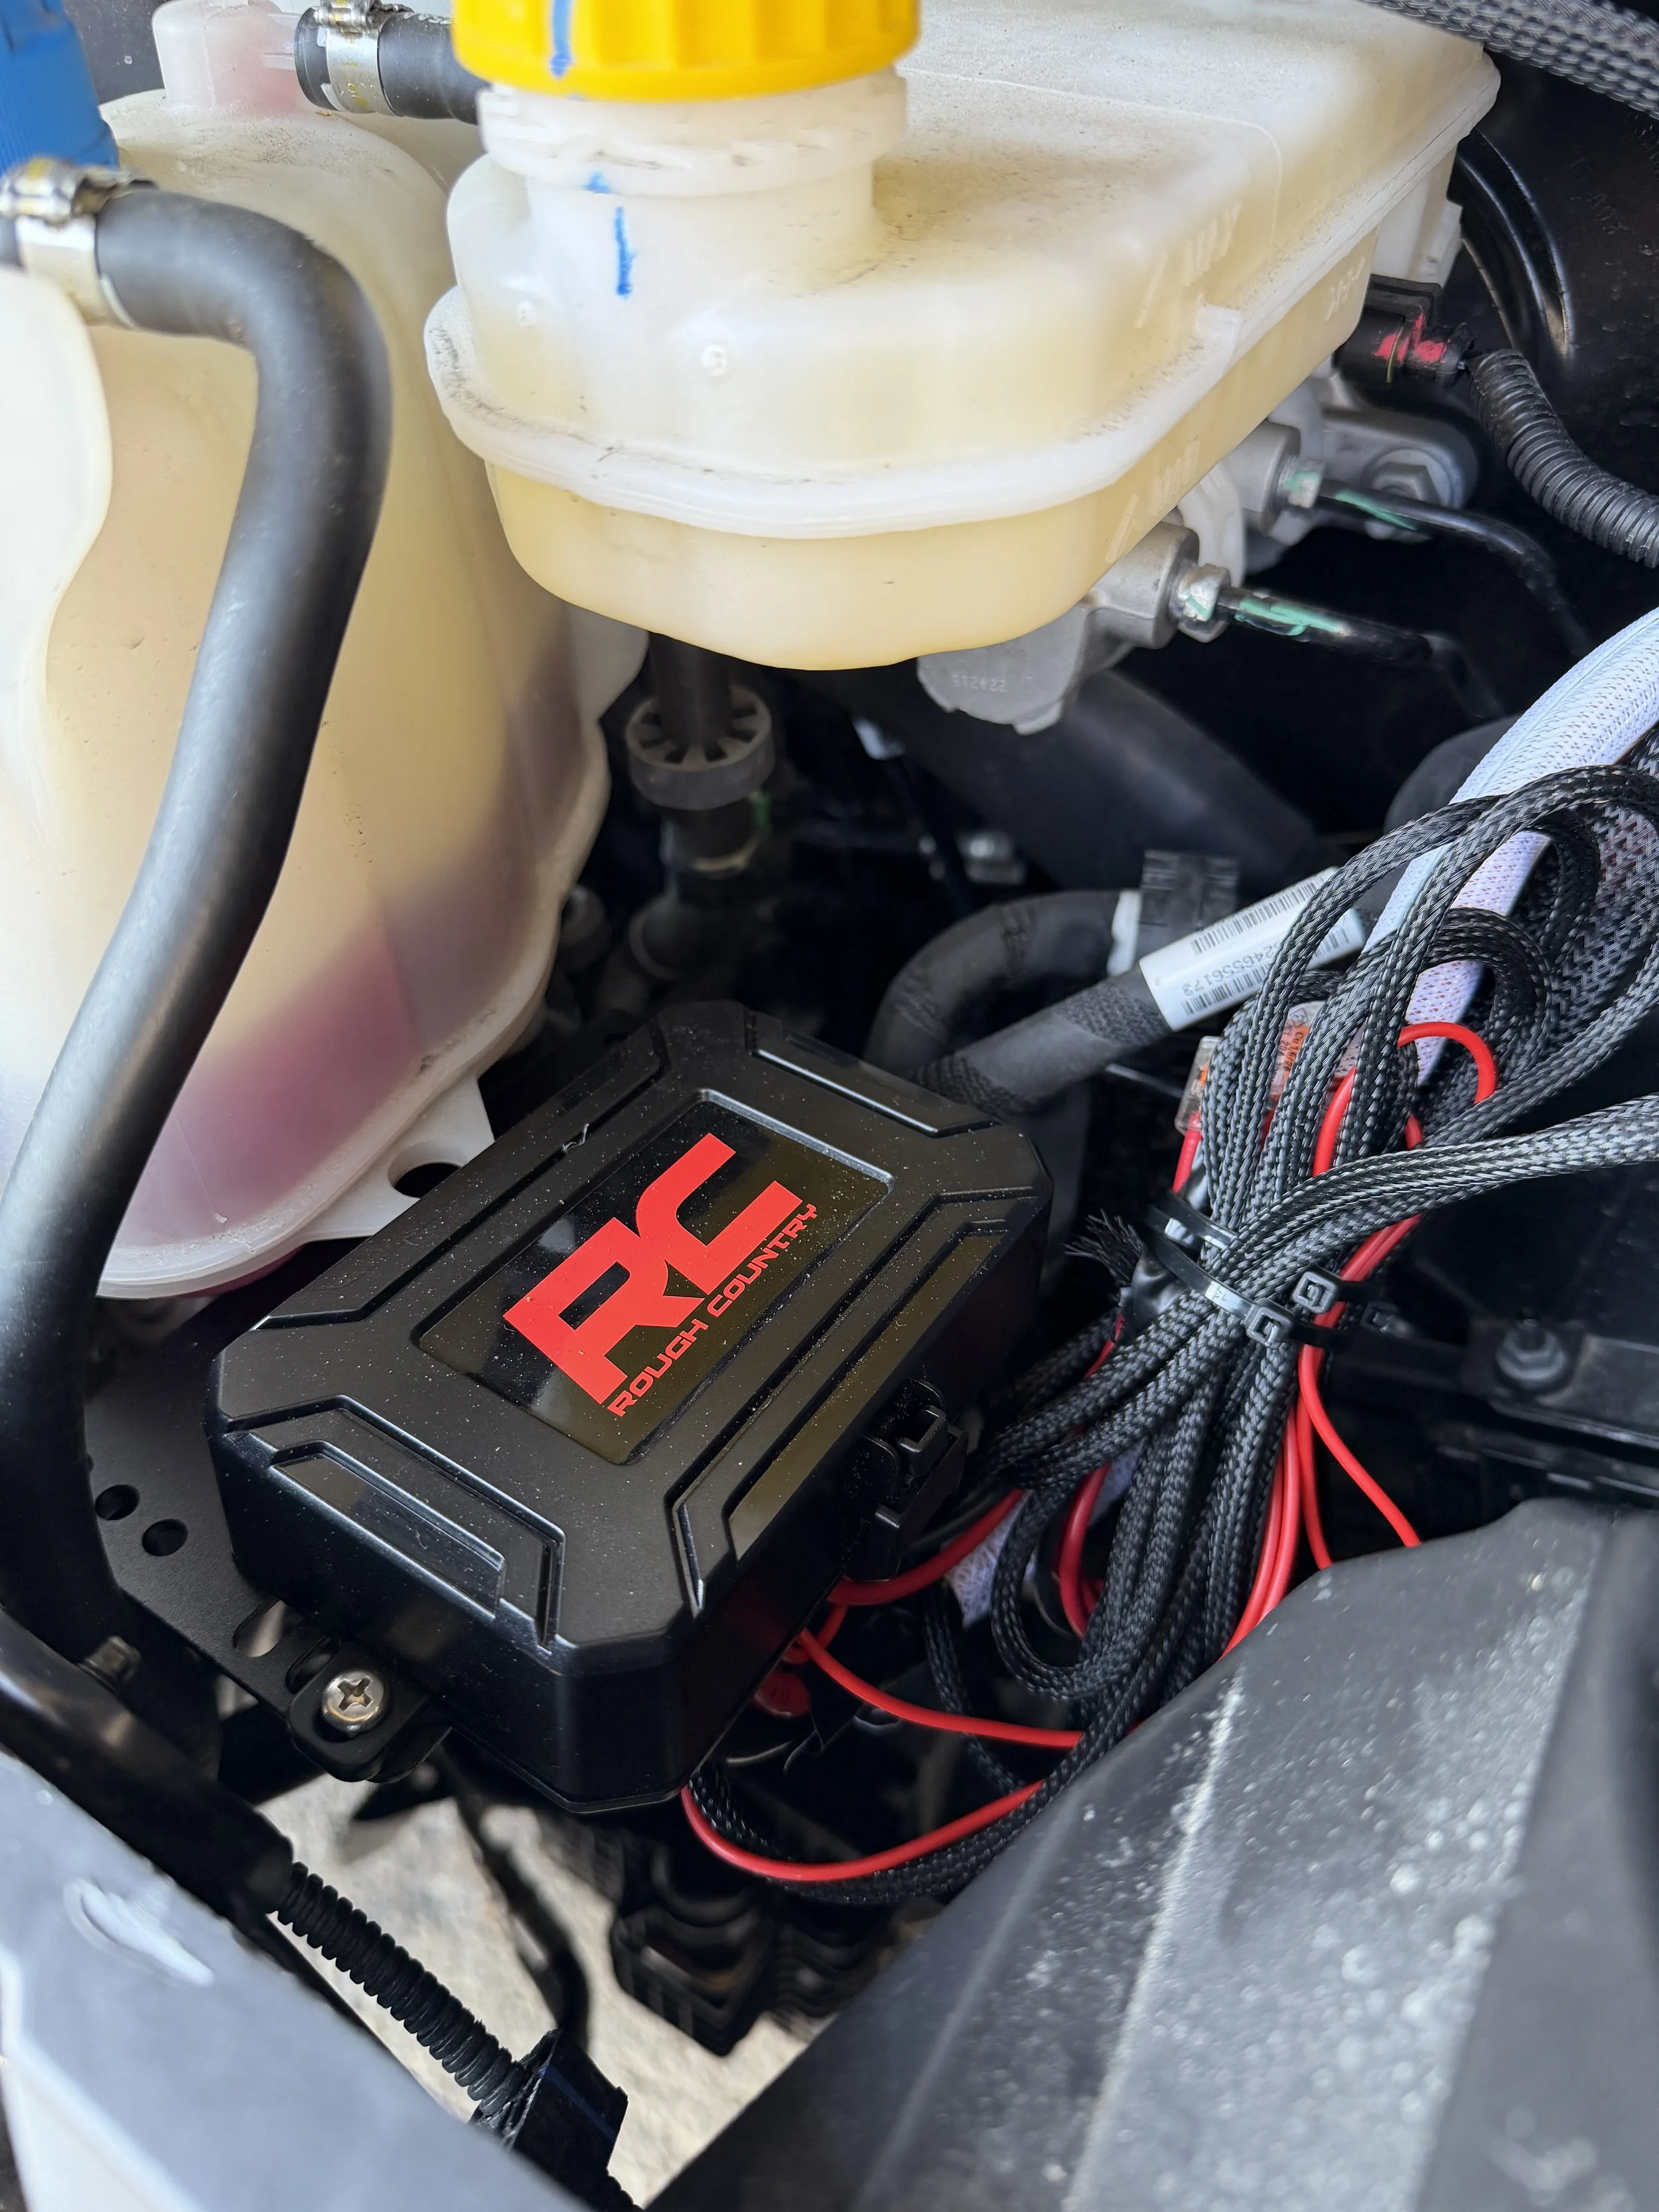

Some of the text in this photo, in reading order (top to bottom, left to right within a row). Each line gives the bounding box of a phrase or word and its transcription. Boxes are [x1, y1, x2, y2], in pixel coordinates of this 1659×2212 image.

[502, 1132, 803, 1405] RC
[607, 1203, 817, 1417] ROUGH COUNTRY
